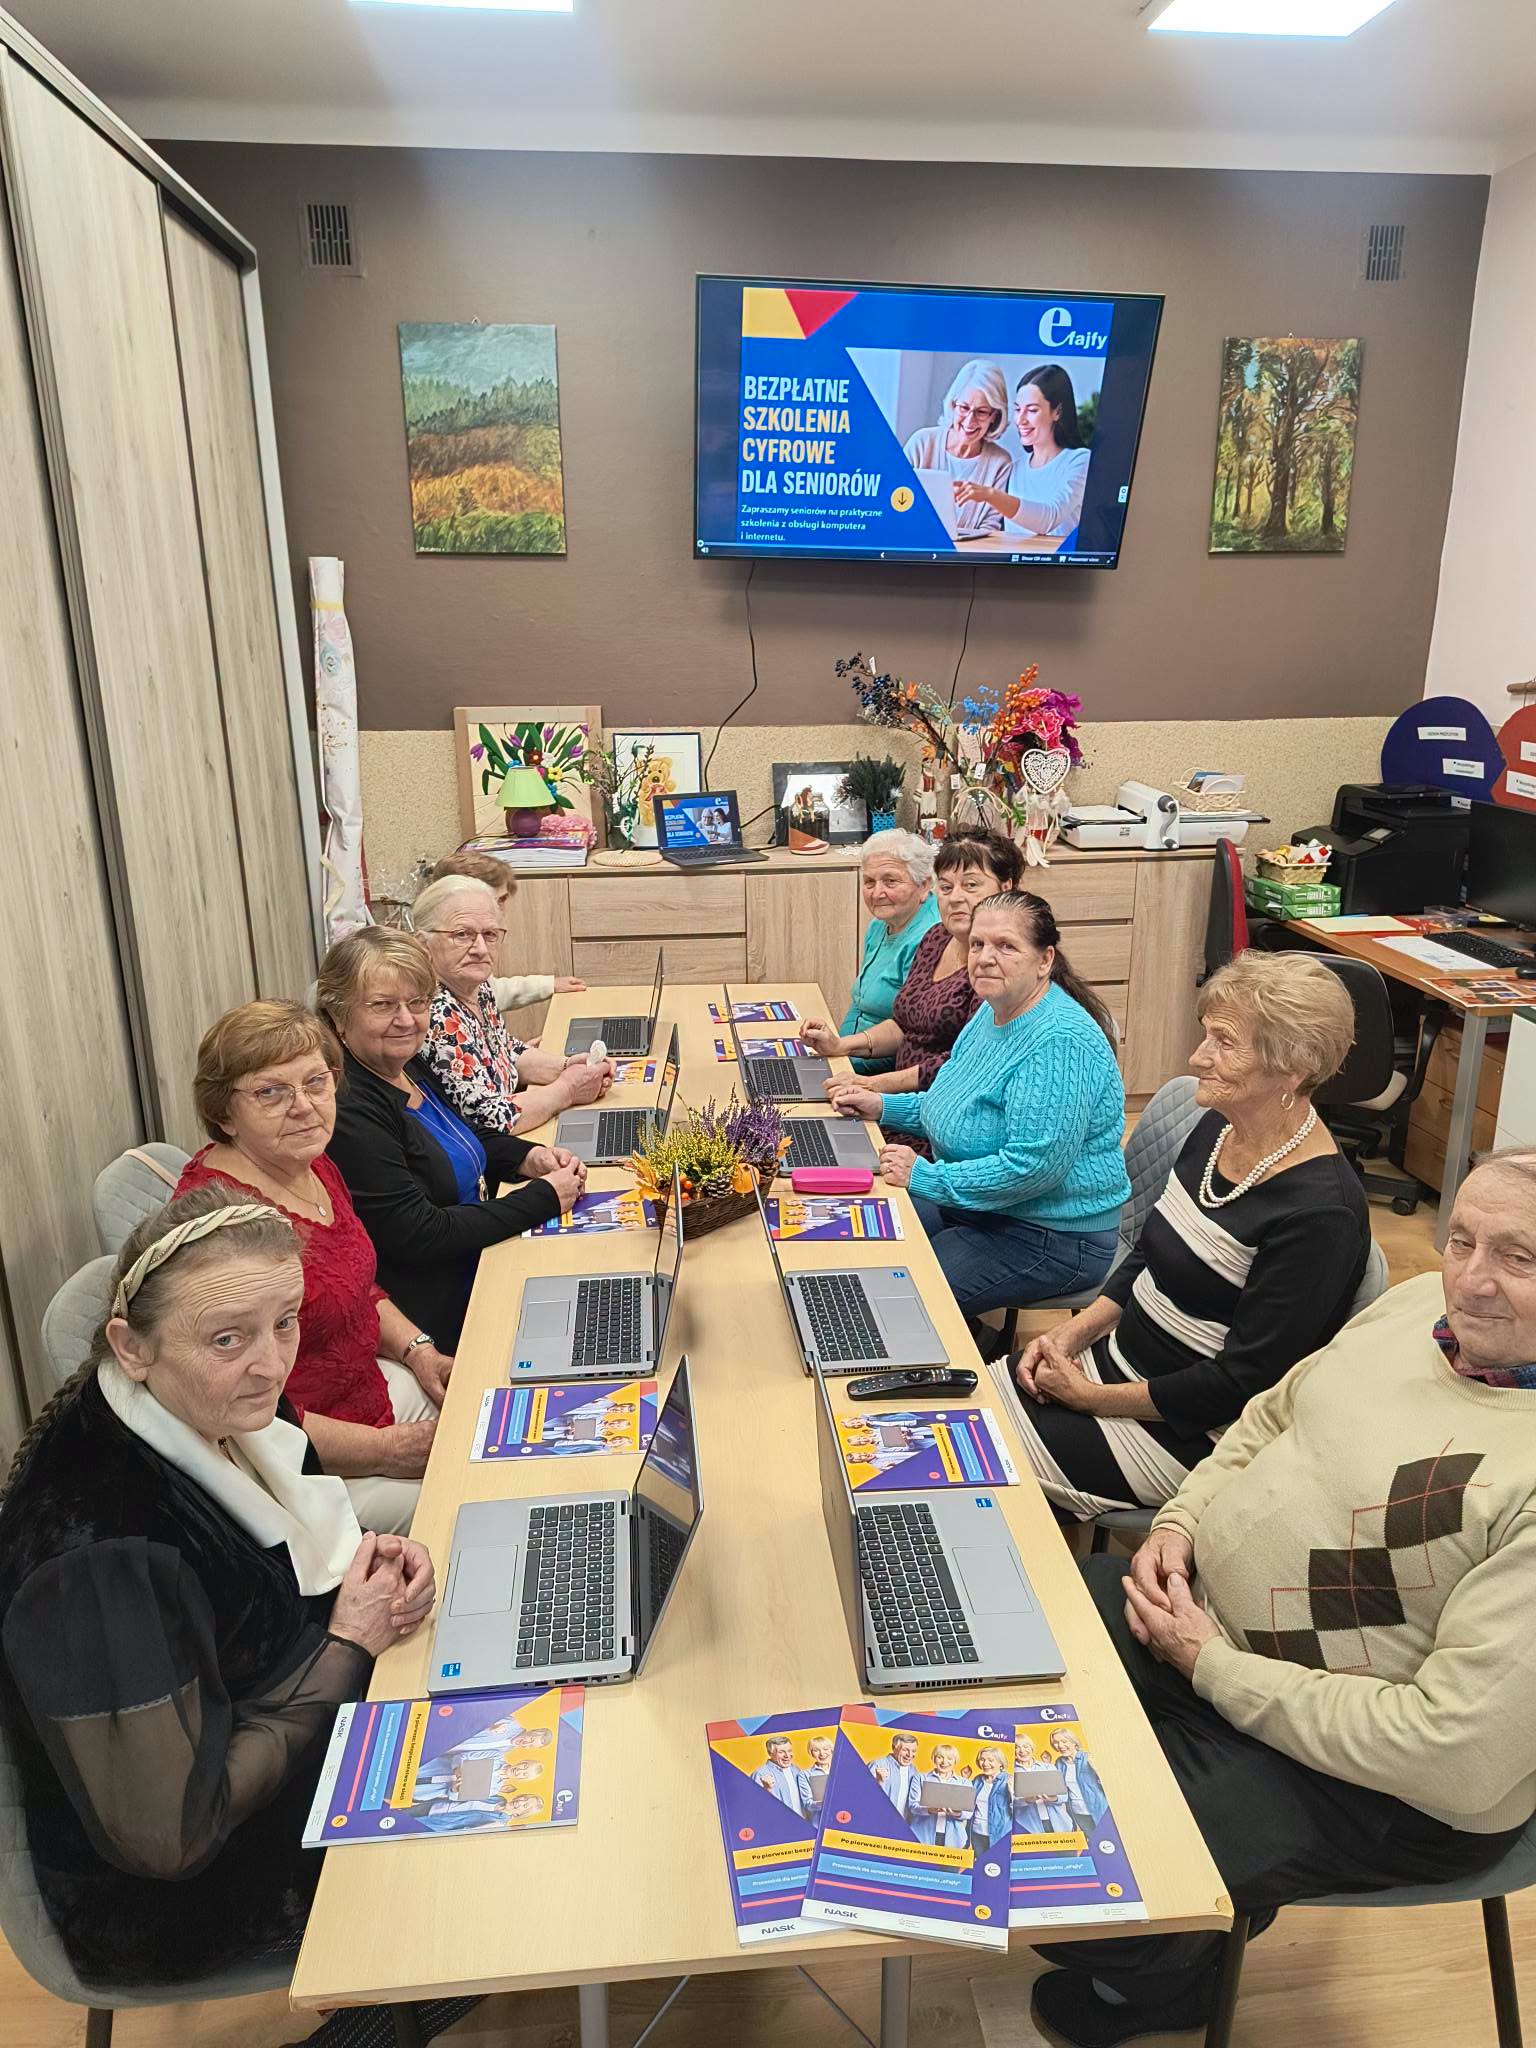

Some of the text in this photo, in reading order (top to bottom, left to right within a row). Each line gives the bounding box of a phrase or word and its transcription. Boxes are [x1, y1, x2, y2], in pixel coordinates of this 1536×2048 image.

[743, 375, 850, 403] BEZPŁATNE
[743, 406, 851, 434] SZKOLENIA
[742, 438, 836, 465] CYFROWE
[741, 468, 881, 497] DLA SENIORÓW
[741, 505, 789, 516] Zapraszamy
[791, 506, 826, 515] seniorów
[839, 508, 883, 518] praktyczne
[740, 519, 780, 527] szkolenia
[788, 520, 819, 531] obsługi
[821, 522, 866, 531] komputera
[740, 531, 785, 541] i internetu.
[336, 1716, 347, 1739] NASK
[824, 1907, 858, 1919] NASK
[761, 1924, 796, 1935] NASK
